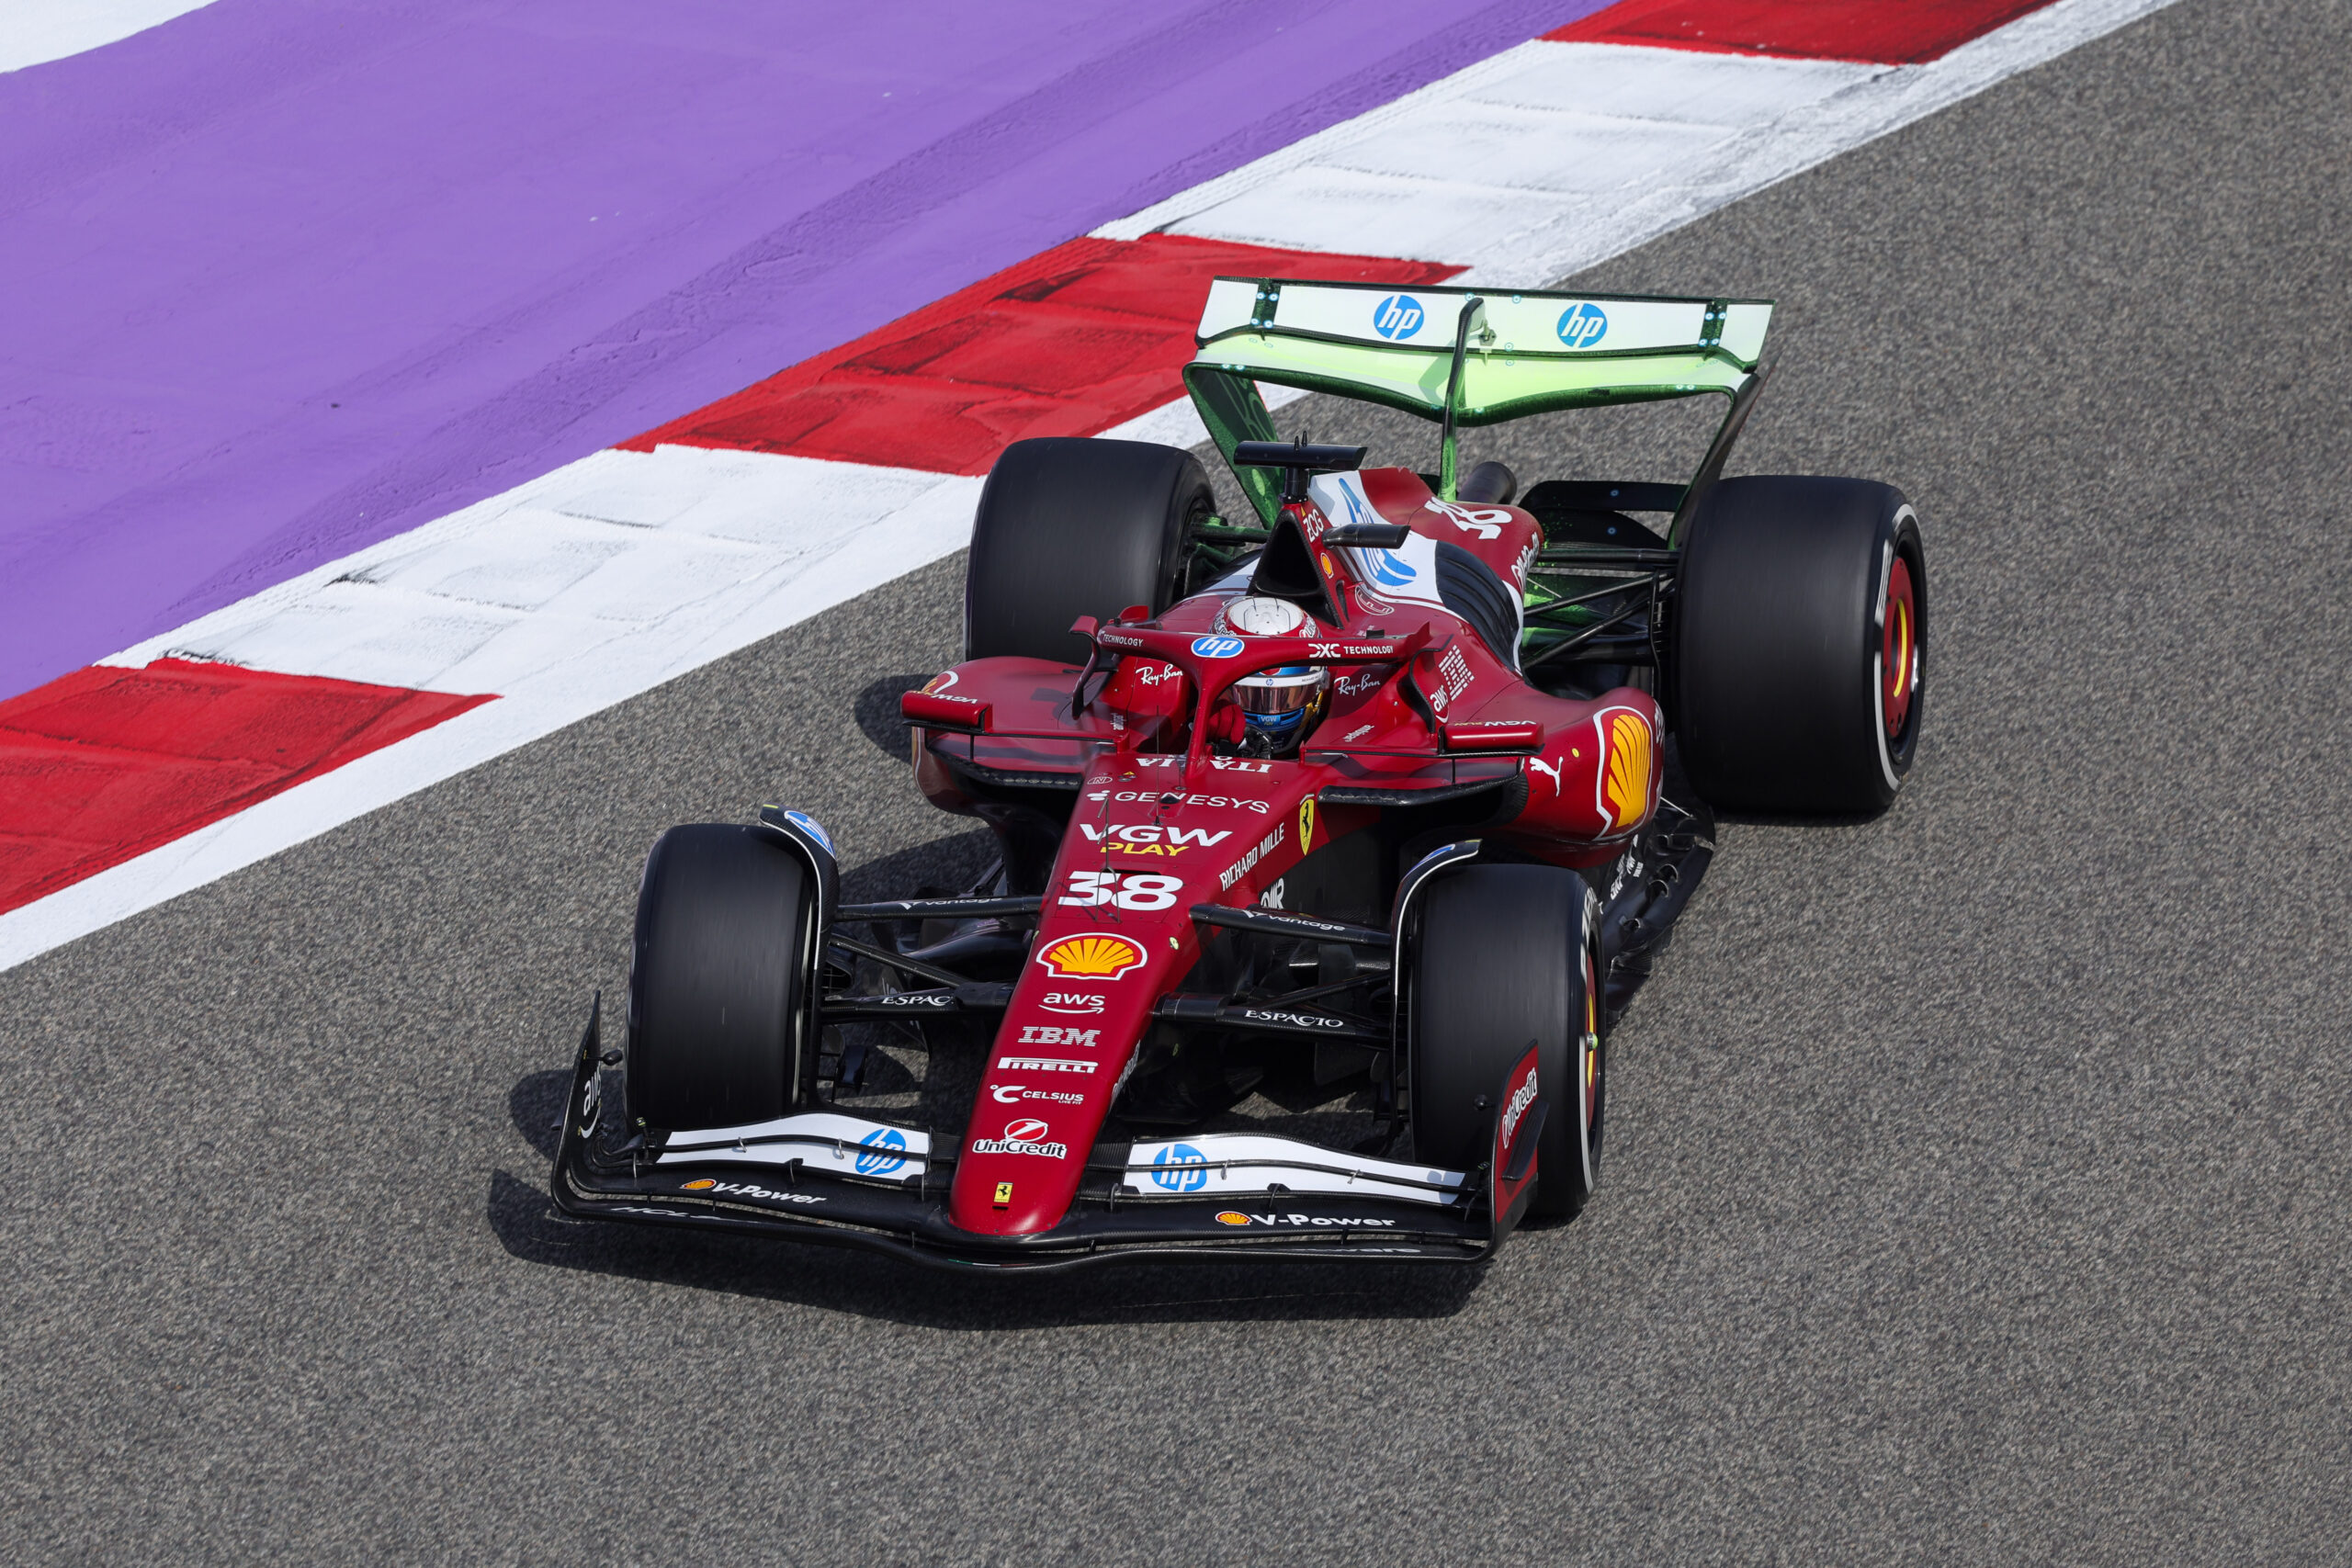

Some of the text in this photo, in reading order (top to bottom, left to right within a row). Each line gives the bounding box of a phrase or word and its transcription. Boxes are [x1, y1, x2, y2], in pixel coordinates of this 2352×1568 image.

[1374, 295, 1424, 340] hp
[1556, 303, 1608, 348] hp
[1103, 634, 1144, 647] TECHNOLOGY
[1191, 636, 1246, 659] hp
[1308, 643, 1394, 658] DXC TECHNOLOGY
[1135, 663, 1183, 685] Ray-Ban
[1438, 645, 1475, 701] IBM
[1333, 673, 1381, 696] Ray-Ban
[1430, 684, 1449, 712] aws
[1114, 791, 1271, 815] GENESYS
[1080, 823, 1233, 847] VGW
[1100, 842, 1190, 856] PLAY
[1219, 822, 1284, 892] RICHARD MILLE
[1057, 870, 1184, 911] 38
[1269, 914, 1346, 931] vantage
[1042, 992, 1105, 1007] aws
[1017, 1026, 1101, 1047] IBM
[997, 1056, 1099, 1074] PIRELLI
[1022, 1090, 1084, 1102] CELSIUS
[854, 1128, 907, 1176] hp
[972, 1139, 1067, 1159] UniCredit
[1150, 1144, 1207, 1191] hp
[713, 1182, 827, 1204] V-Power
[1250, 1213, 1396, 1227] V-Power
